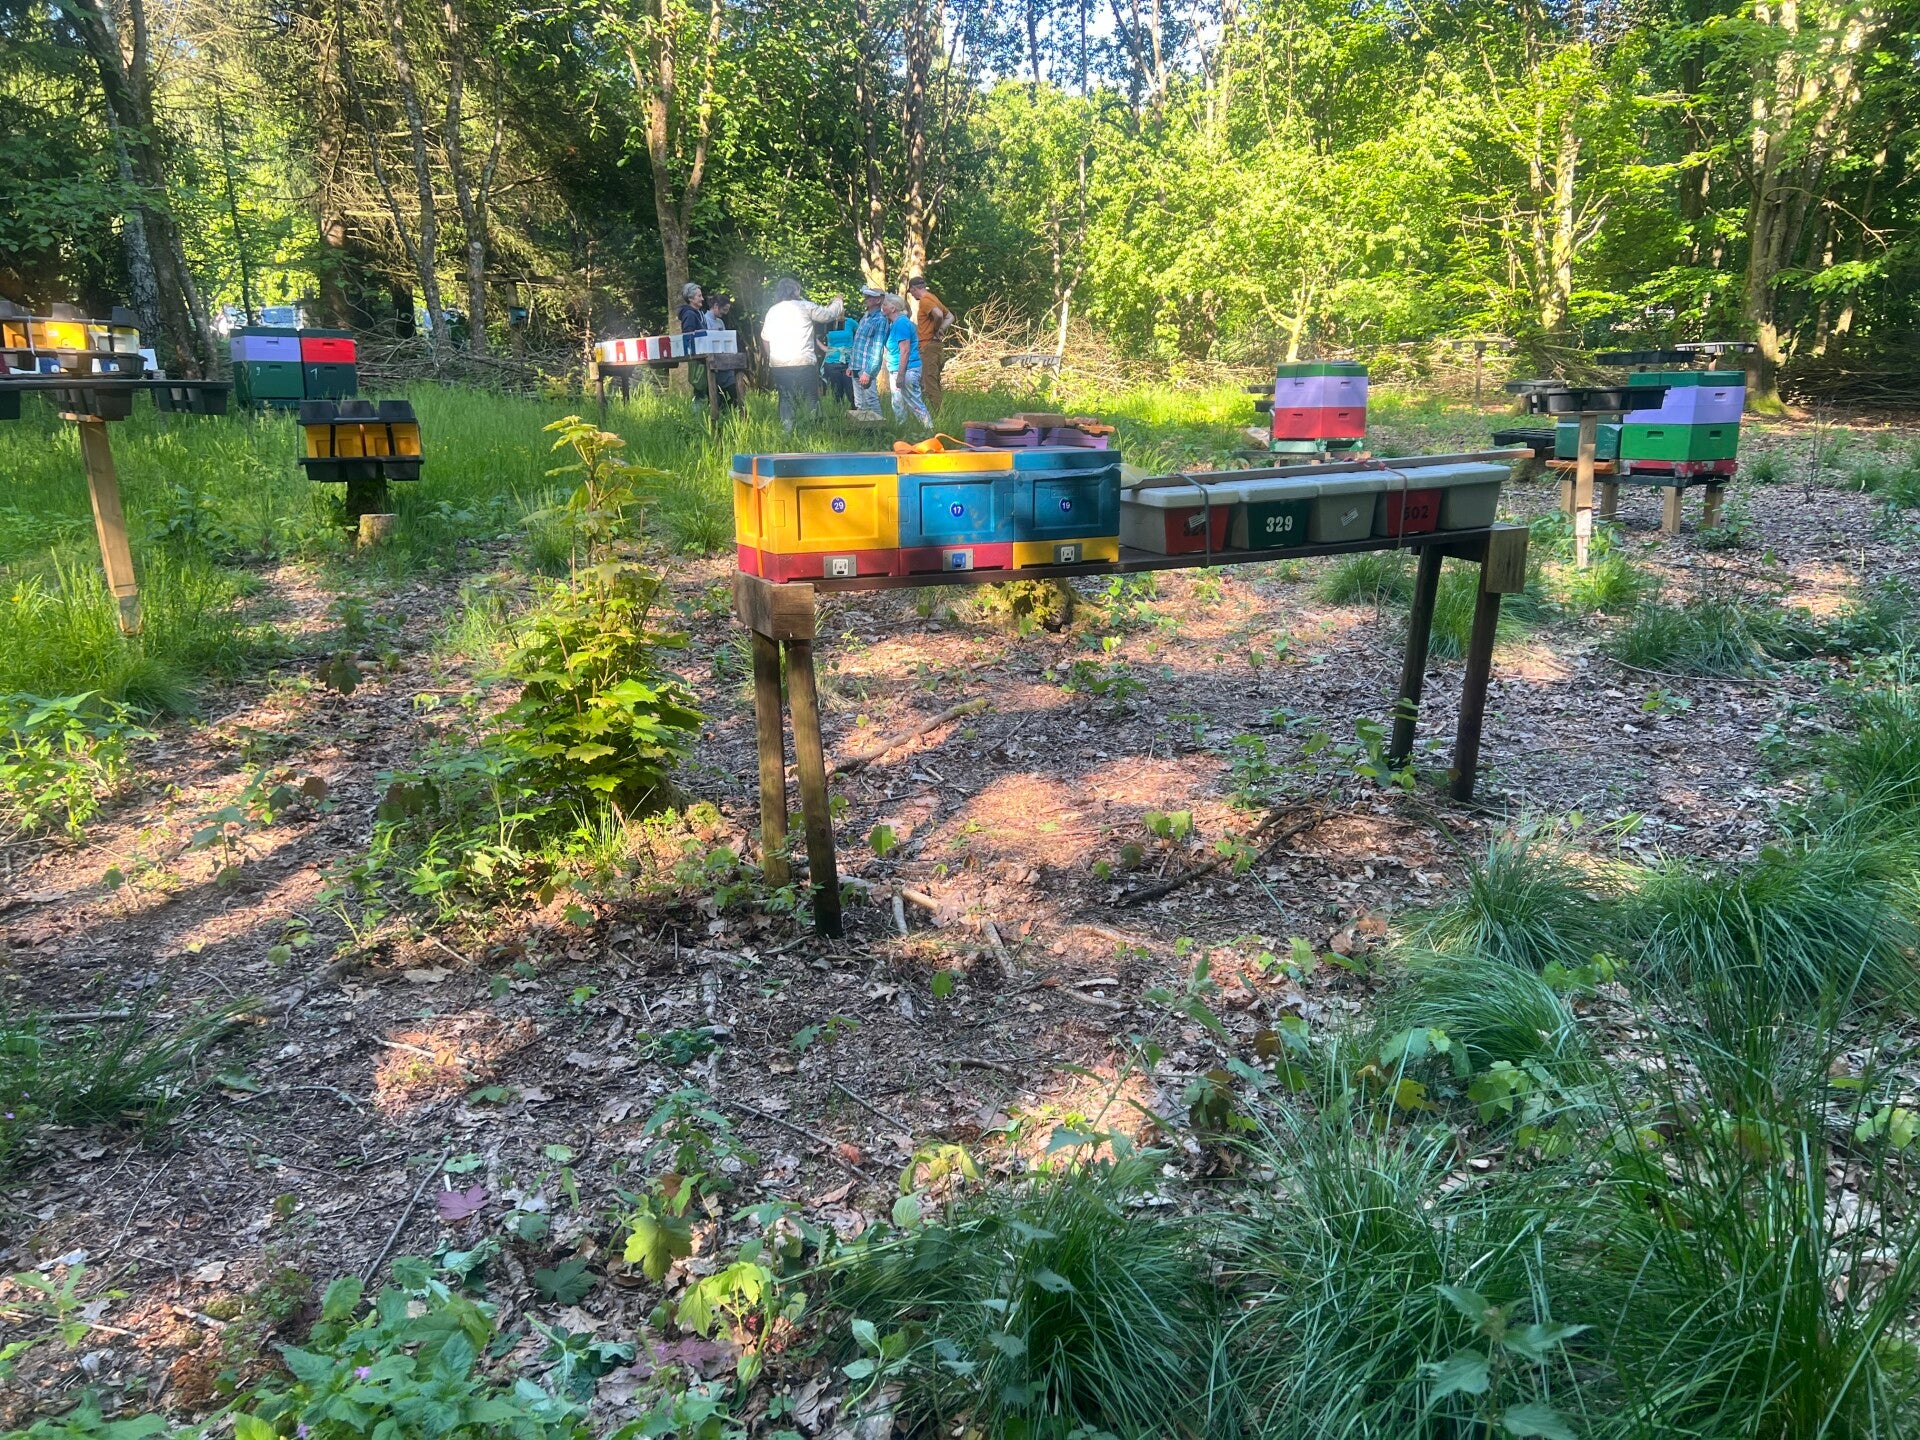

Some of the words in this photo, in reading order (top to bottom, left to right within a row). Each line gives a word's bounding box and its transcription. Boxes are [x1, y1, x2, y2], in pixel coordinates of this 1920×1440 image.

[834, 501, 844, 510] 29
[953, 506, 962, 514] 17
[1062, 501, 1071, 510] 19
[1266, 515, 1293, 532] 329
